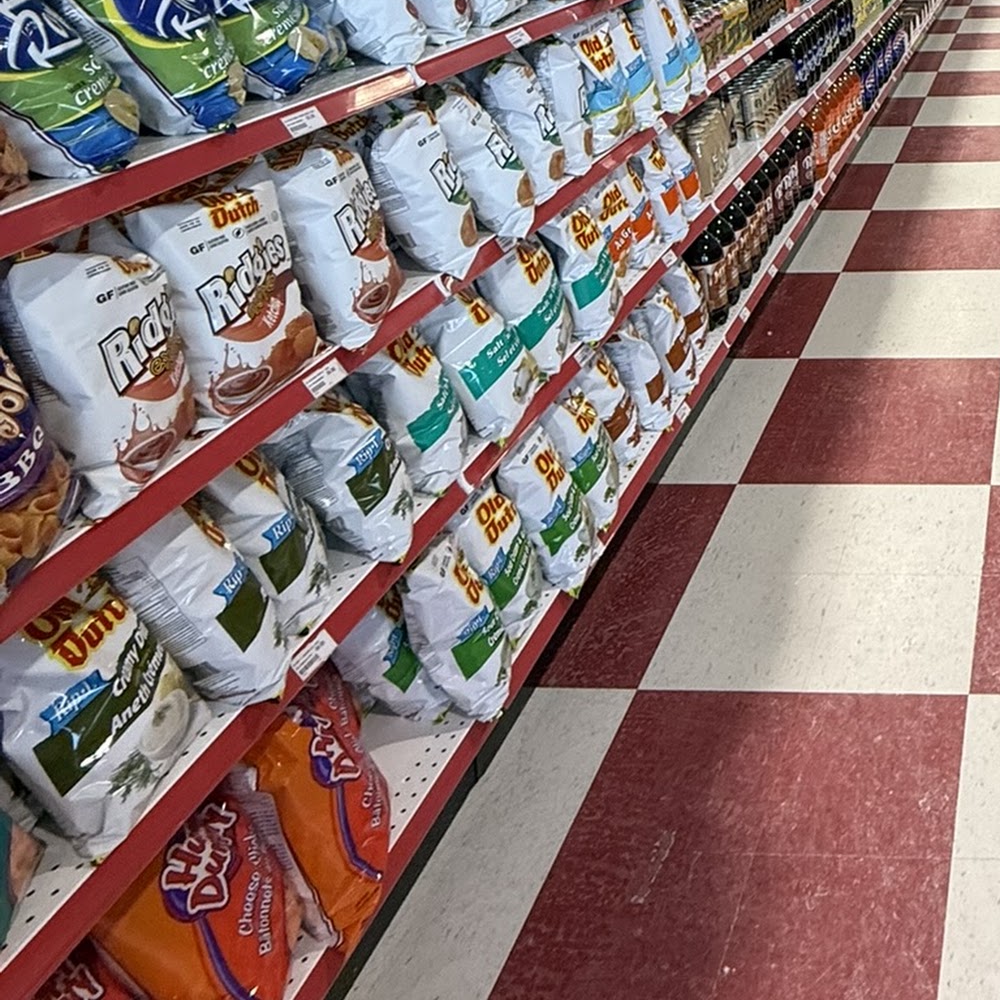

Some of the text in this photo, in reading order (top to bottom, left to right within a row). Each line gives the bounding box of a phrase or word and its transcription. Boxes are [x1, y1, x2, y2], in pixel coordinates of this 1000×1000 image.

[210, 197, 260, 230] Dutch
[190, 244, 207, 255] GF
[96, 290, 117, 304] GF
[195, 233, 288, 336] Ridgies
[486, 339, 504, 360] Salt
[475, 494, 505, 526] Old
[108, 685, 151, 736] Aneth
